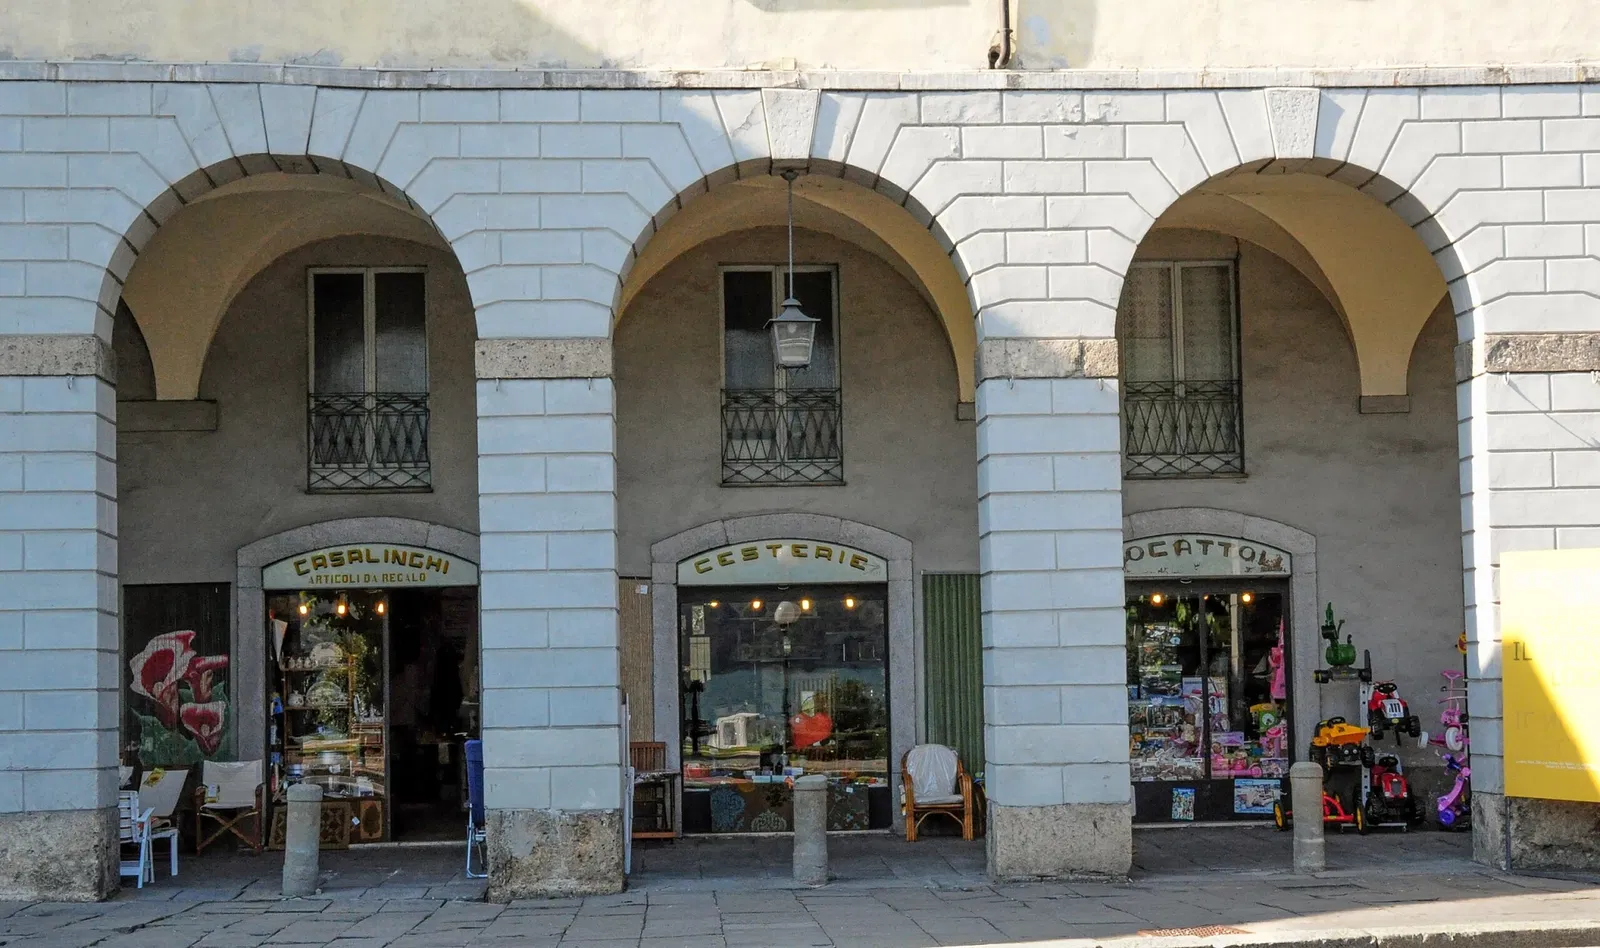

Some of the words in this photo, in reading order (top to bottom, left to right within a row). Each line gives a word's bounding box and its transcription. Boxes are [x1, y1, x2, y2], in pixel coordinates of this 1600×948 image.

[293, 548, 450, 577] CASALINGHI
[693, 543, 869, 574] CESTERIE
[308, 573, 360, 585] ARTICOLI
[364, 573, 378, 584] DA
